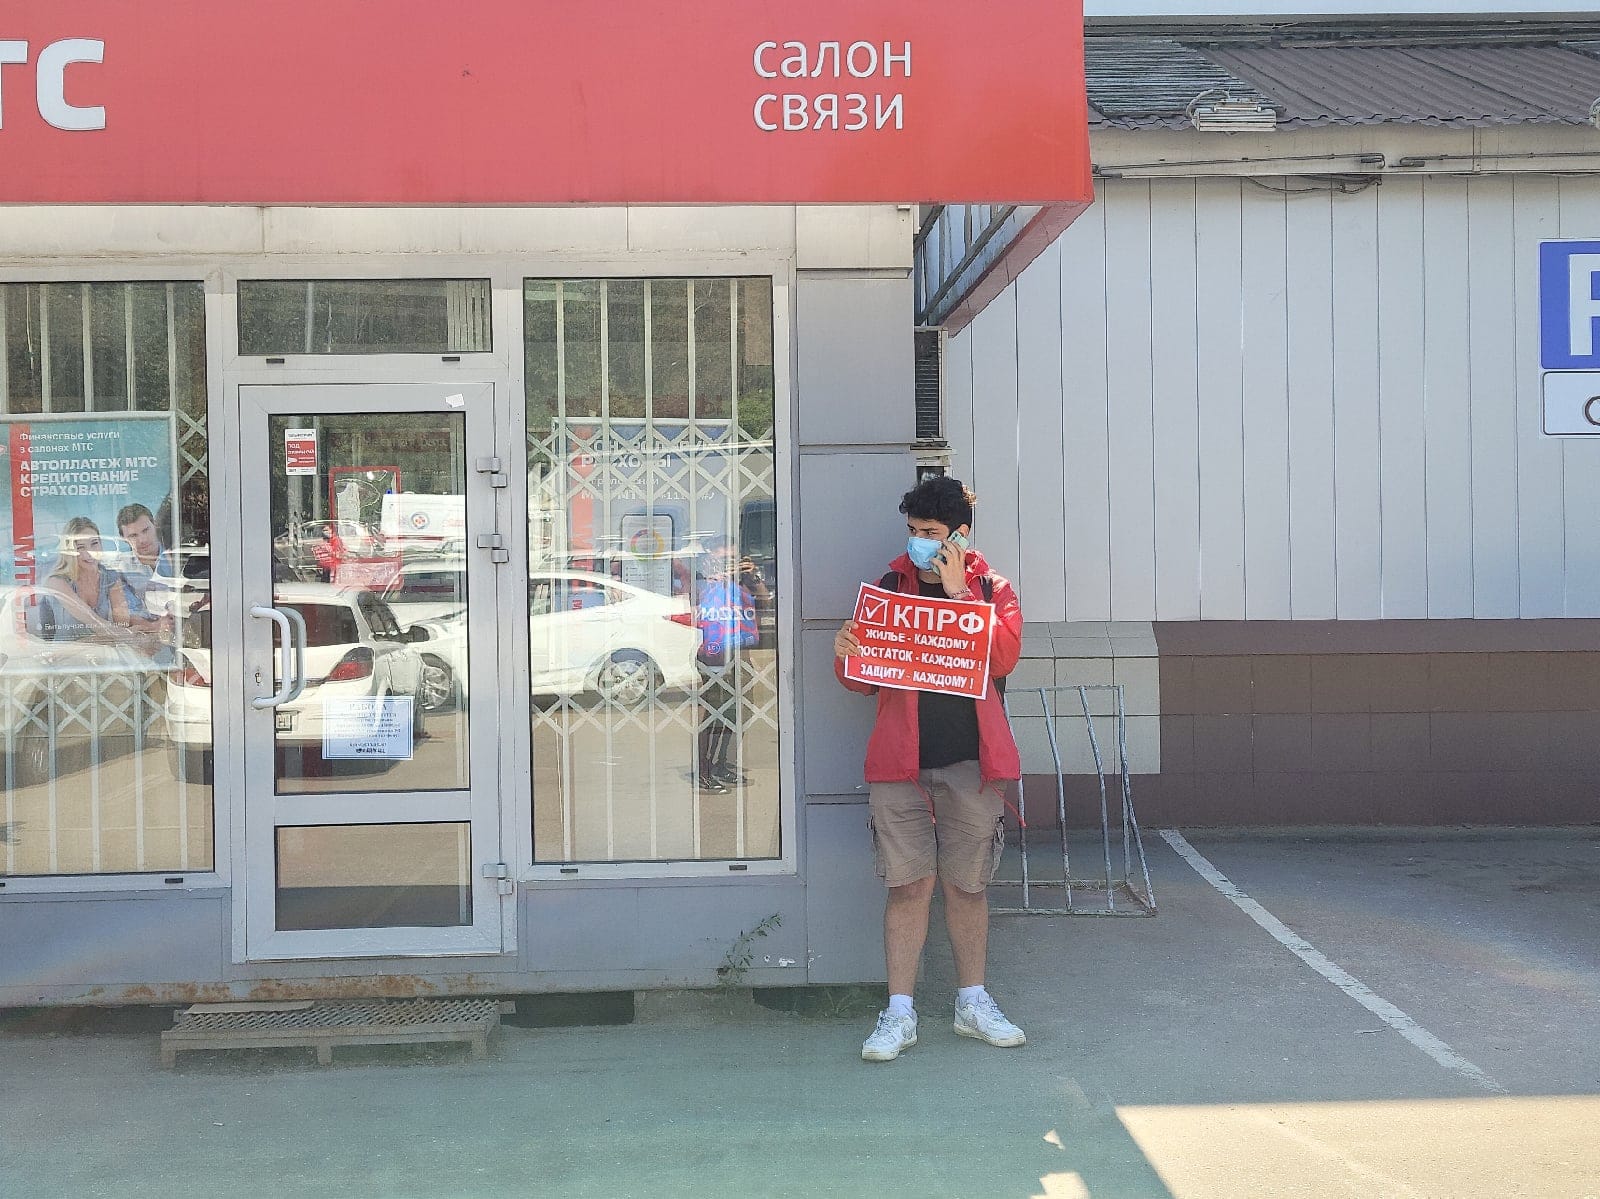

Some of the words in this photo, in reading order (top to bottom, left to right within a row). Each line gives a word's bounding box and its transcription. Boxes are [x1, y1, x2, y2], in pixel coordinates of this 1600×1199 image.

[753, 40, 911, 78] салон
[753, 93, 903, 131] связи
[87, 430, 120, 440] услуги
[28, 444, 69, 453] салонах
[72, 442, 94, 452] МТС
[20, 457, 121, 472] АВТОПЛАТЕЖ
[126, 456, 158, 469] МТС
[20, 470, 139, 485] КРЕДИТОВАНИЕ
[20, 484, 128, 497] СТРАХОВАНИЕ
[893, 604, 985, 635] КПРФ
[865, 628, 906, 643] ЖИЛЬЕ
[914, 633, 968, 650] КАЖДОМУ
[921, 652, 975, 669] КАЖДОМУ
[860, 663, 905, 680] ЗАЩИТУ
[913, 671, 967, 688] КАЖДОМУ
